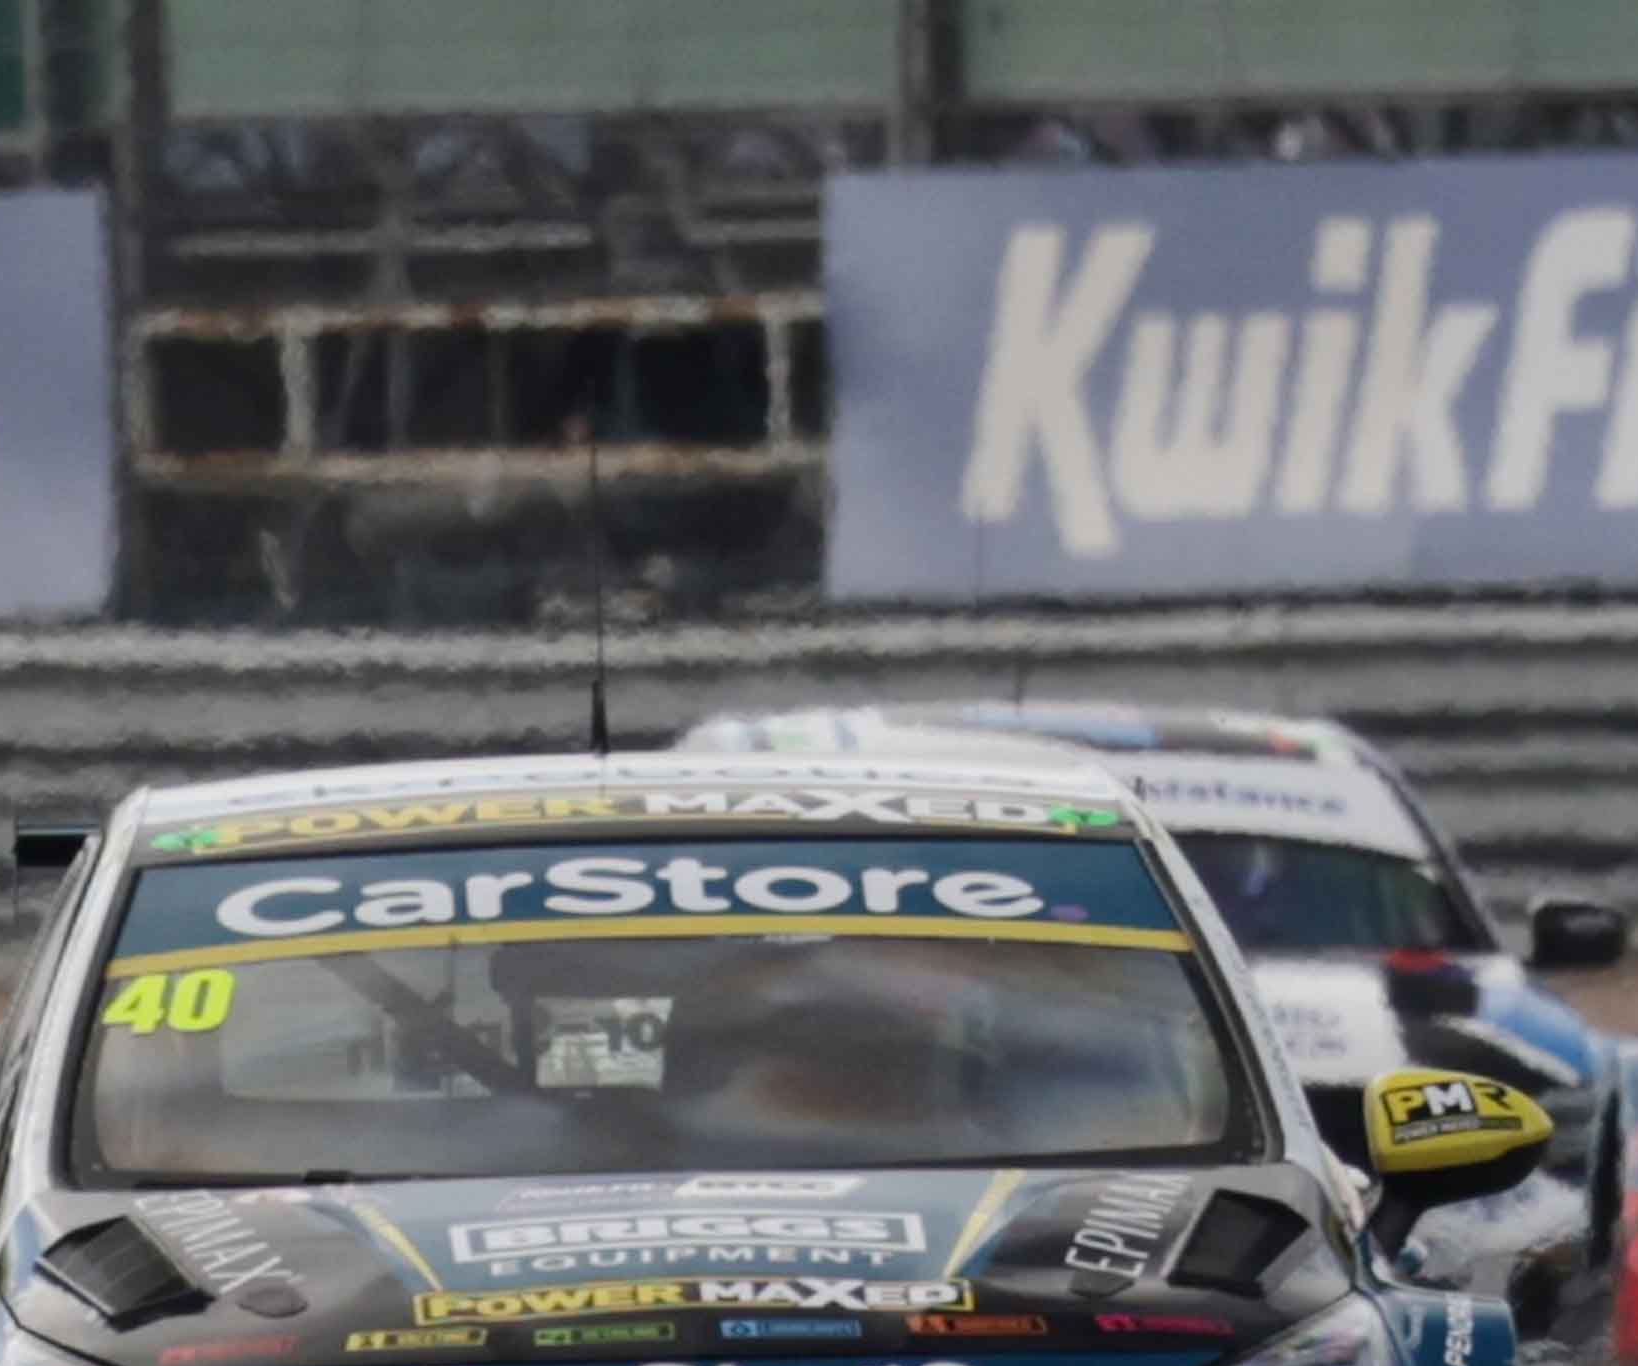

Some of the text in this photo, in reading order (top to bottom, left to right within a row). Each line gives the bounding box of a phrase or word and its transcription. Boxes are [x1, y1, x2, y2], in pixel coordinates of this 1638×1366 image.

[219, 790, 1051, 844] POWER MAXED
[103, 969, 235, 1033] 40
[1385, 1080, 1510, 1123] PMR
[480, 1214, 892, 1252] BRIGGS
[490, 1246, 896, 1277] EQUIPMENT
[428, 1278, 963, 1319] POWER MAXED
